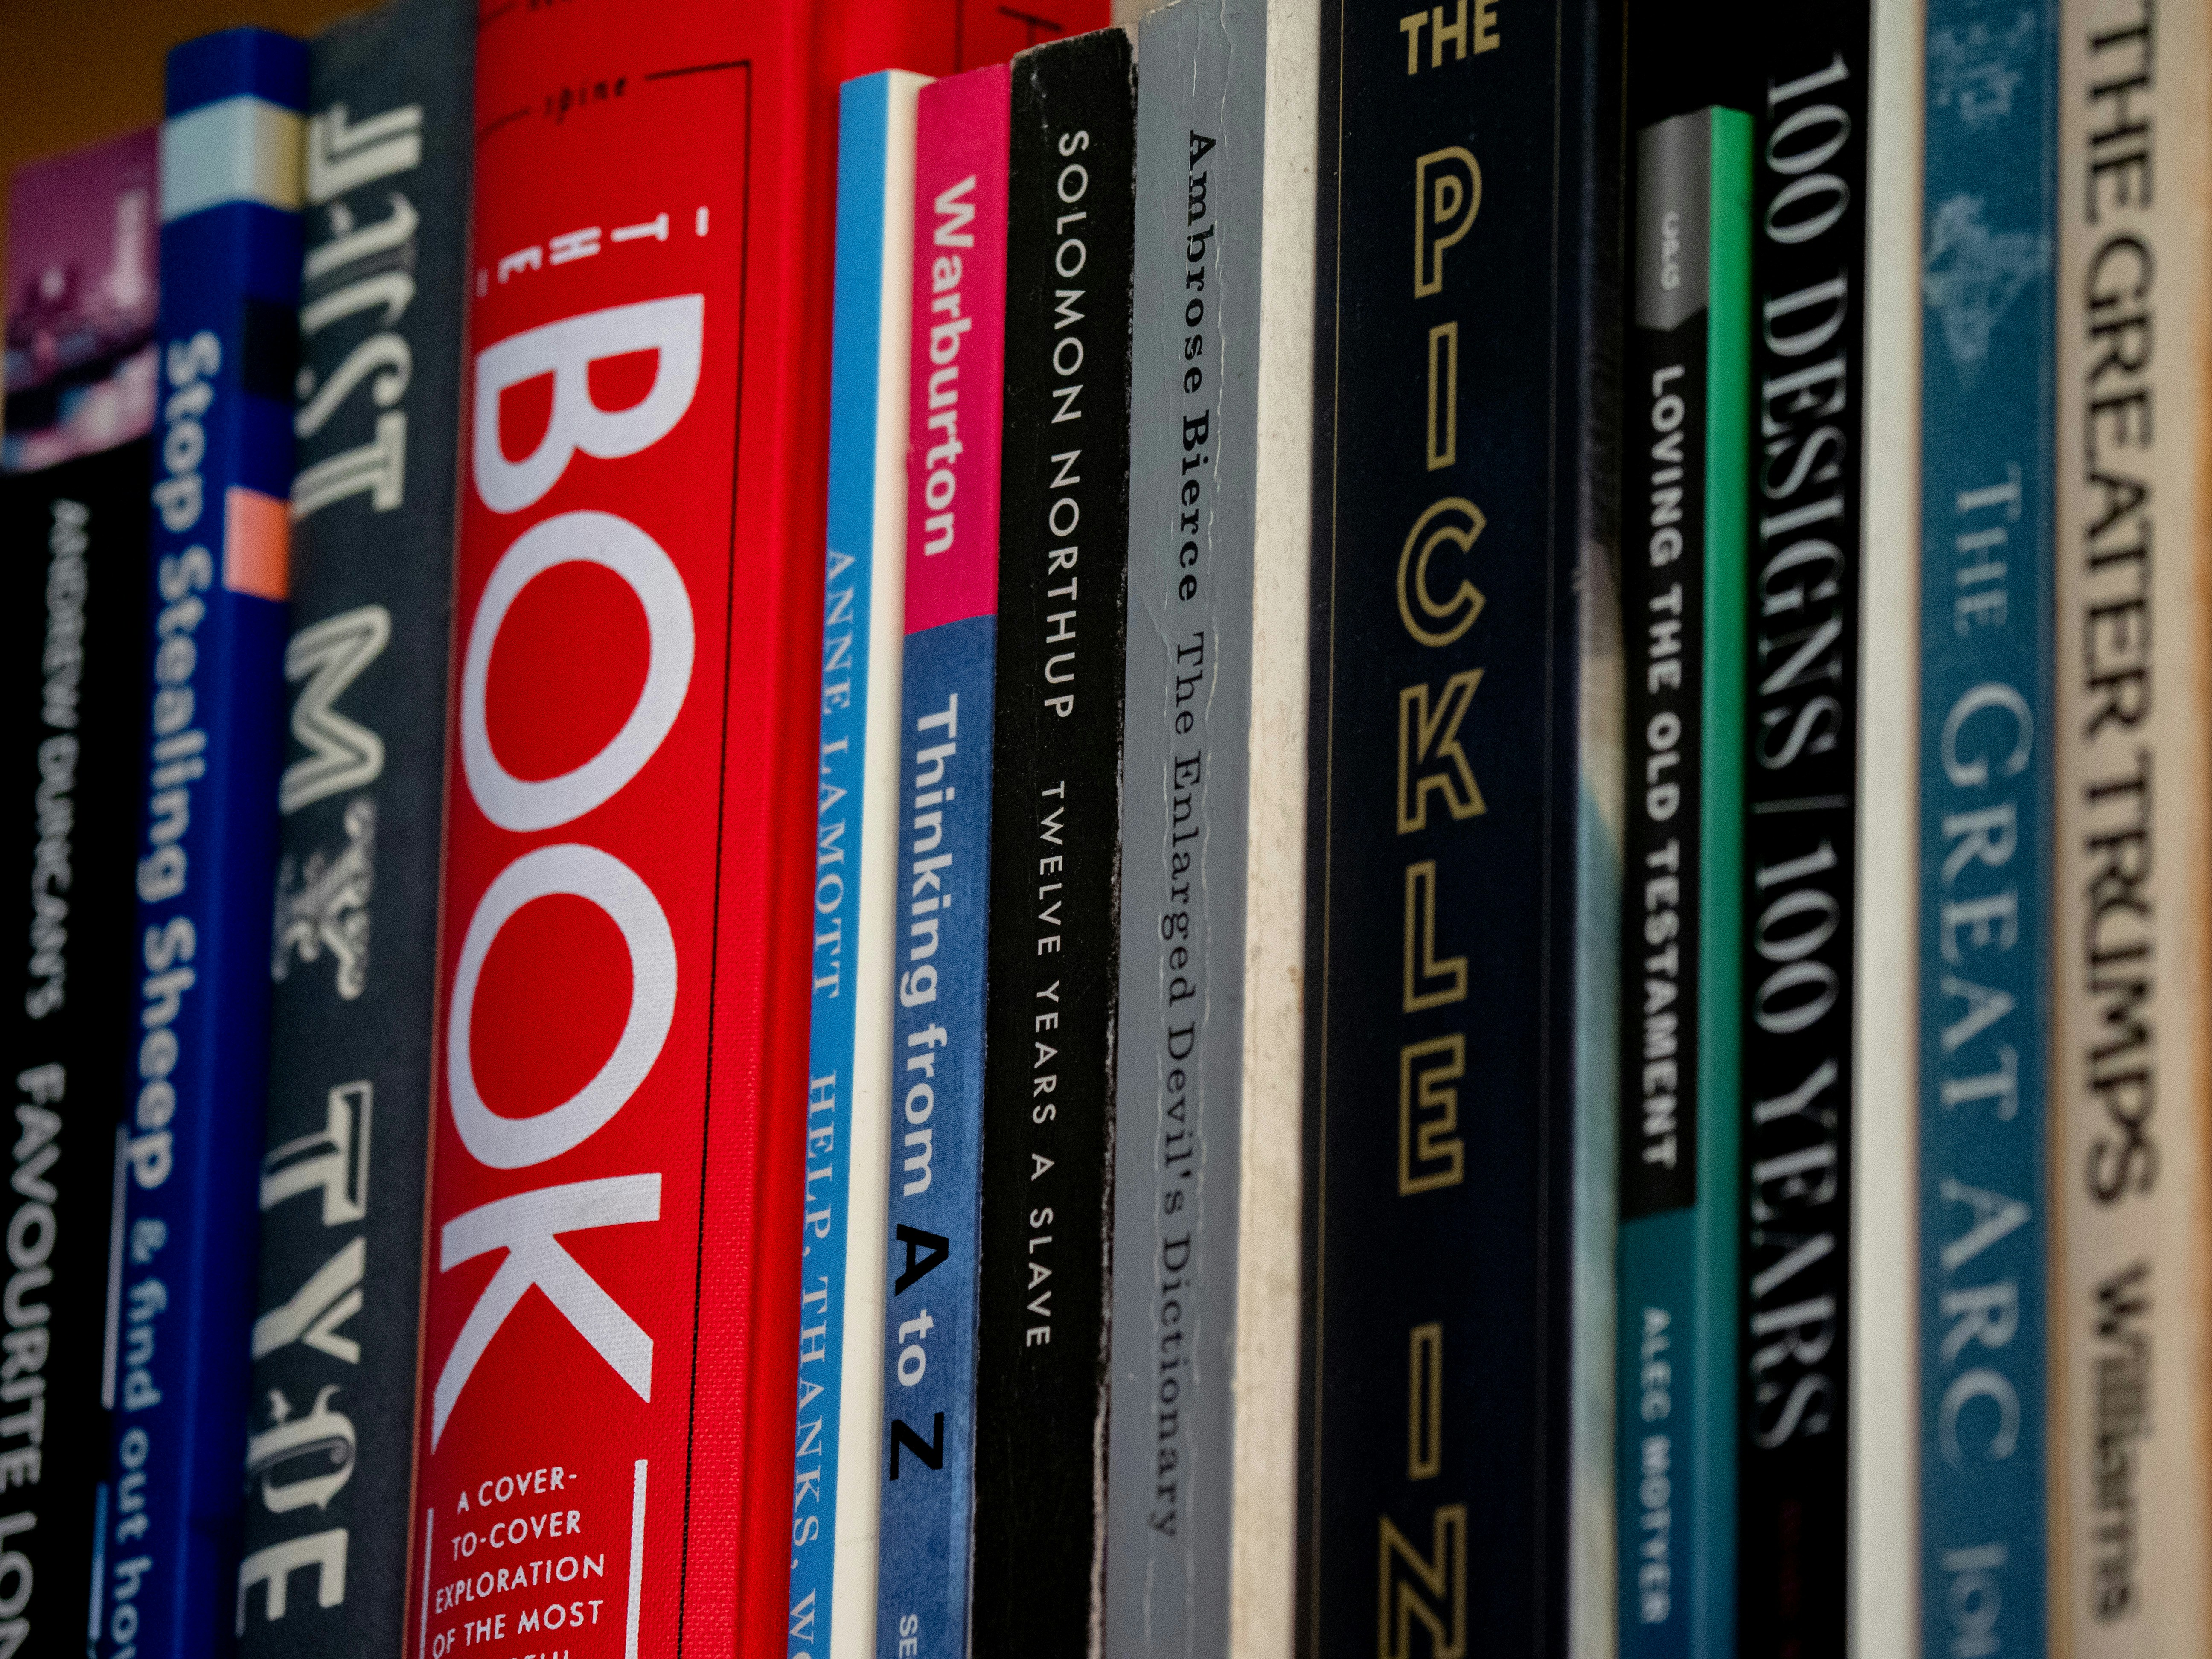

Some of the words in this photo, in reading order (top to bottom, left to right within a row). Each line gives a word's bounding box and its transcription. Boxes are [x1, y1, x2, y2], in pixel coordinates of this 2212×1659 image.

[1400, 0, 1499, 75] THE
[2085, 0, 2156, 224] THE
[499, 213, 669, 281] THE
[1767, 58, 1848, 243] 100
[288, 104, 423, 521] JUST
[1052, 130, 1089, 423] SOLOMON
[1183, 130, 1216, 393] Ambrose
[151, 329, 222, 533] Stop
[925, 175, 976, 556] Warburton
[1650, 366, 1684, 566] LOVING
[1044, 450, 1081, 717] NORTHUP
[1179, 409, 1209, 601] Bierce
[1759, 277, 1848, 767] DESIGNS
[1956, 470, 2020, 634] THE
[2084, 233, 2155, 743] GREATER
[43, 500, 89, 729] ANDREW
[821, 548, 855, 715] ANNE
[1175, 631, 1205, 734] The
[1397, 146, 1486, 1195] PICKLE
[1649, 585, 1682, 692] THE
[138, 545, 213, 902] Stealing
[271, 604, 392, 1000] MY
[1647, 713, 1680, 820] OLD
[26, 735, 78, 1018] DUNCAN'S
[432, 294, 705, 1456] BOOK
[812, 736, 848, 999] LAMOTT
[901, 693, 958, 1007] Thinking
[1038, 781, 1065, 955] TWELVE
[1162, 750, 1202, 1007] Enlarged
[1756, 845, 1835, 1032] 100
[1941, 683, 2030, 1117] GREAT
[127, 917, 197, 1189] Sheep
[1032, 981, 1059, 1124] YEARS
[1644, 841, 1679, 1165] TESTAMENT
[2084, 748, 2162, 1207] TRUMPS
[802, 1069, 836, 1257] HELP,
[904, 1023, 947, 1196] from
[1031, 1153, 1054, 1180] A
[1164, 1021, 1195, 1215] Devil's
[0, 1064, 65, 1492] FAVOURITE
[122, 1278, 167, 1411] find
[895, 1224, 949, 1296] A
[898, 1309, 934, 1386] to
[1026, 1208, 1054, 1346] SLAVE
[1752, 1062, 1837, 1445] YEARS
[1940, 1179, 2028, 1456] ARC
[236, 1080, 373, 1638] TYPE
[790, 1275, 828, 1569] THANKS,
[890, 1412, 944, 1481] Z
[1148, 1232, 1192, 1537] Dictionary
[1642, 1308, 1671, 1419] ALEC
[2090, 1263, 2155, 1623] Williams
[117, 1429, 148, 1541] out
[435, 1554, 604, 1614] EXPLORATION
[451, 1510, 581, 1561] TO-COVER
[457, 1491, 469, 1514] A
[478, 1466, 577, 1507] COVER-
[1379, 1322, 1467, 1659] IN
[432, 1628, 456, 1659] OF
[465, 1614, 506, 1645] THE
[518, 1600, 603, 1633] MOST
[899, 1614, 918, 1659] SE
